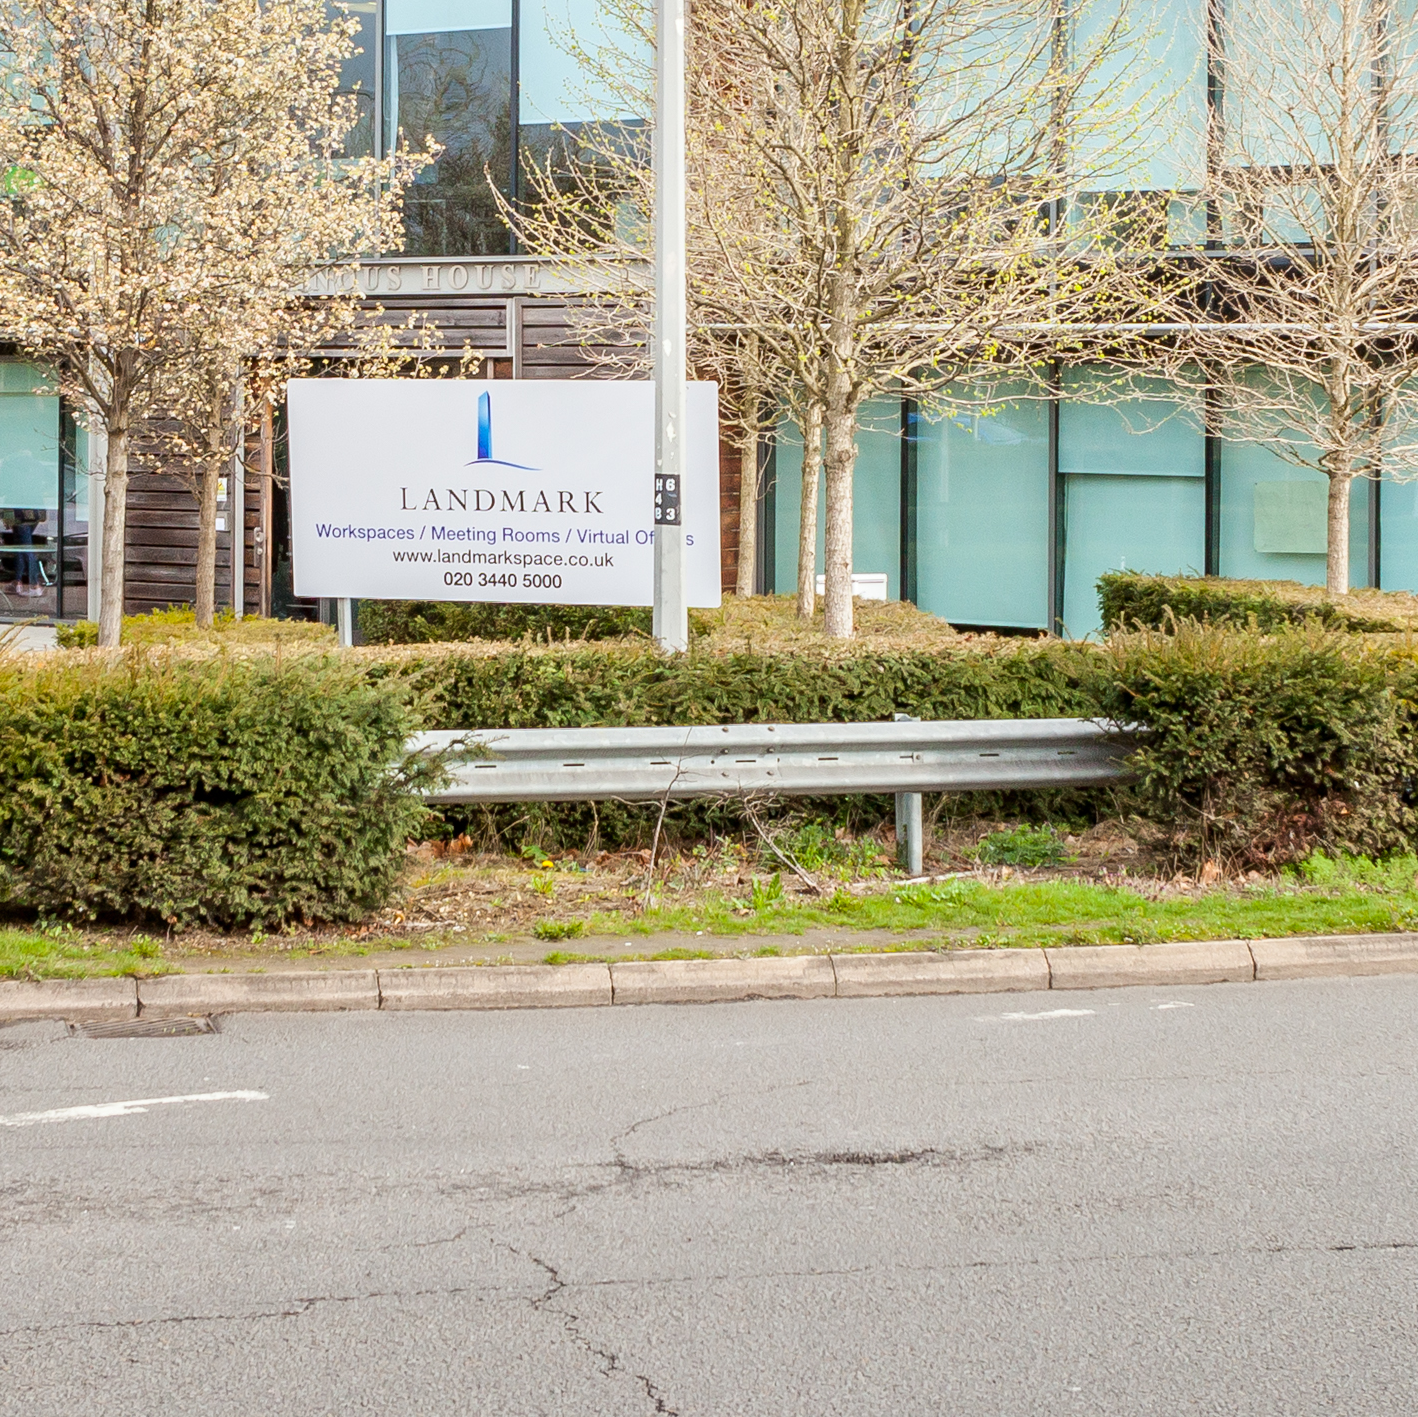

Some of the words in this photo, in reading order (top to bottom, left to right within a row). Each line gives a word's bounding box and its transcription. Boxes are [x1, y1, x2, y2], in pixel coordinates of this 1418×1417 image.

[421, 263, 542, 291] HOUSE
[399, 486, 605, 514] LANDMARK
[315, 523, 415, 542] Workspaces
[431, 525, 497, 546] Meeting
[502, 527, 561, 543] Rooms
[576, 528, 629, 545] Virtual
[392, 548, 615, 569] www.landmarkspace.co.uk
[443, 571, 474, 587] 020
[477, 572, 518, 588] 3440
[522, 573, 563, 589] 5000
